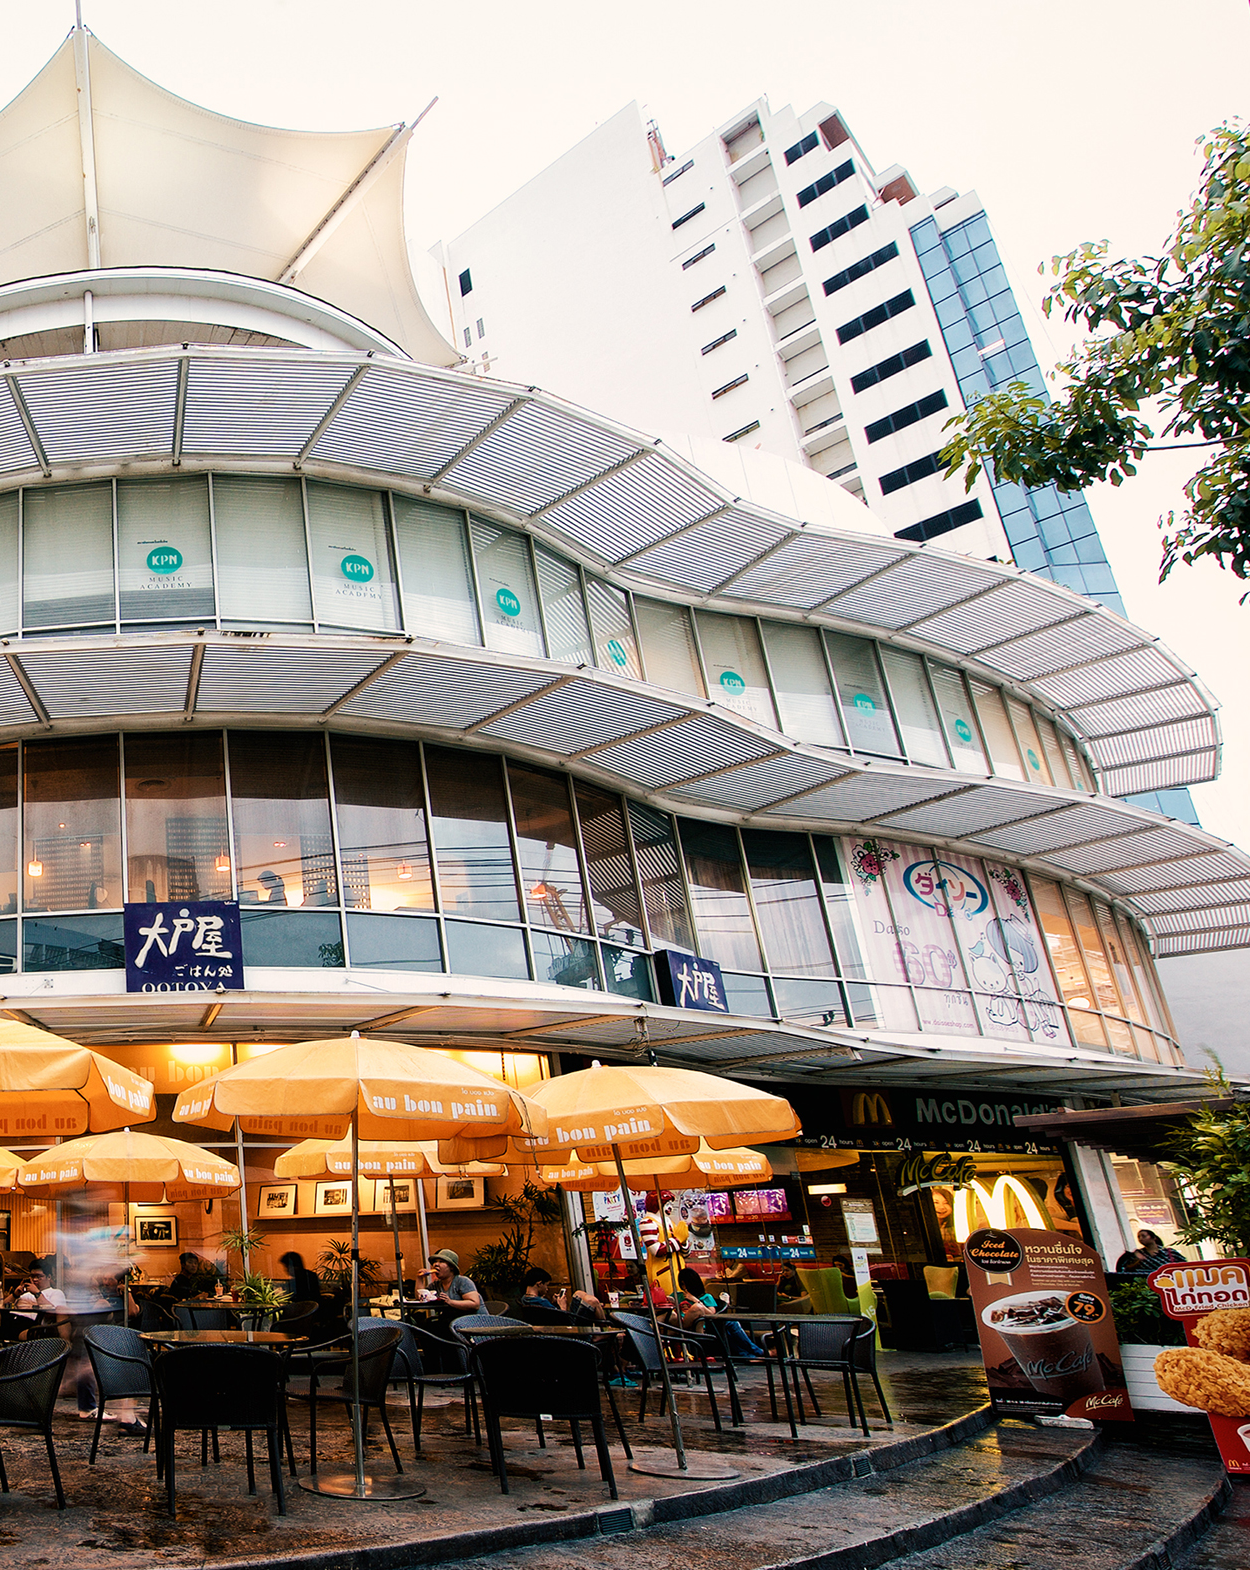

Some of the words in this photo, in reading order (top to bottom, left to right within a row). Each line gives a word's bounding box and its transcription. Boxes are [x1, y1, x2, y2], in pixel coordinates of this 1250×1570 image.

[152, 555, 177, 565] KPN
[346, 562, 369, 575] KPN
[335, 589, 382, 599] ACADEMY
[344, 583, 374, 592] MUSIC
[499, 595, 518, 610] KPN
[723, 678, 743, 688] KPN
[915, 872, 978, 901] ダイソー
[134, 908, 233, 968] 大戸屋
[175, 964, 233, 977] ごはん処
[892, 941, 953, 988] 60
[142, 982, 226, 993] OOTOYA
[677, 962, 725, 1010] 大戸屋
[168, 1060, 219, 1083] bon
[128, 1089, 150, 1110] pain
[373, 1096, 397, 1110] au
[404, 1094, 443, 1114] bon
[451, 1099, 498, 1119] pain
[915, 1098, 1059, 1125] McDona'
[556, 1127, 596, 1143] bon
[603, 1118, 652, 1141] pain
[820, 1135, 837, 1149] 24
[895, 1138, 912, 1151] 24
[966, 1139, 981, 1152] 24
[1024, 1141, 1038, 1155] 24
[334, 1160, 351, 1170] au
[386, 1159, 416, 1172] pain
[698, 1161, 711, 1169] au
[713, 1160, 735, 1170] bon
[737, 1160, 762, 1173] pain
[24, 1172, 37, 1182] au
[40, 1170, 57, 1181] bon
[59, 1167, 78, 1181] pain
[196, 1166, 212, 1180] bon
[214, 1170, 235, 1184] pain
[548, 1170, 559, 1179] au
[561, 1167, 575, 1178] bon
[578, 1166, 594, 1178] pain
[604, 1194, 621, 1204] PARTY
[981, 1240, 1005, 1250] Iced
[1024, 1241, 1082, 1255] หวานชื่นใจ
[737, 1247, 748, 1258] 24
[790, 1248, 800, 1258] 24
[969, 1248, 1019, 1258] Chocolate
[1026, 1254, 1094, 1267] ในราคาพิเศษสุด
[1174, 1267, 1245, 1288] แมค
[1163, 1287, 1248, 1305] ไก่ทอด
